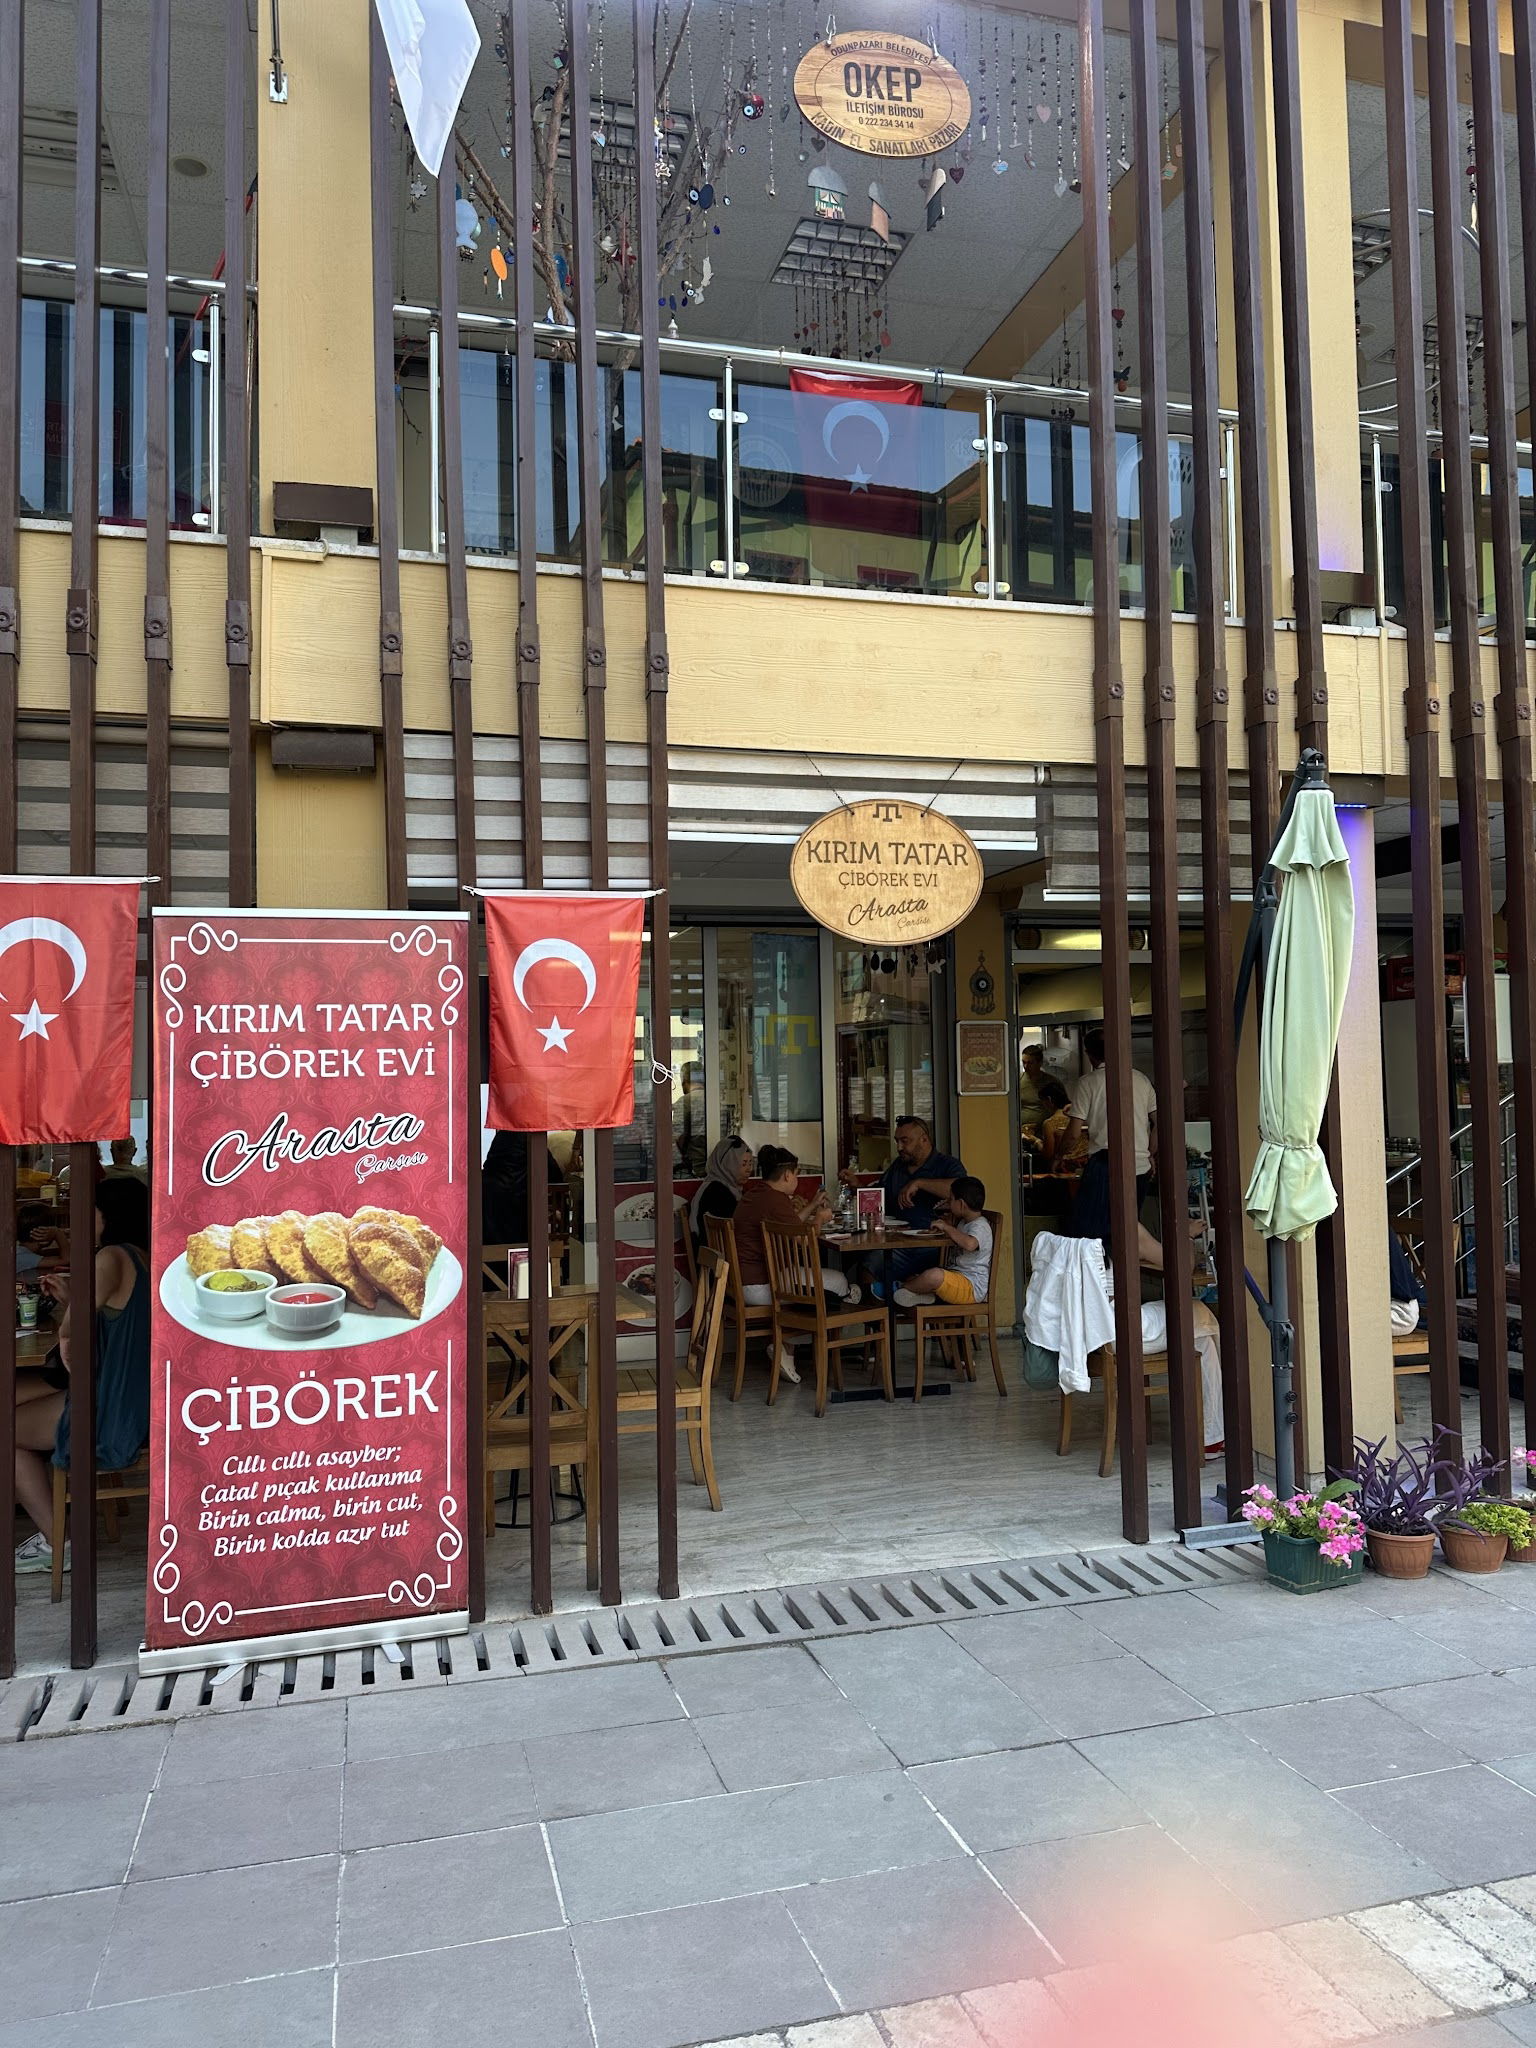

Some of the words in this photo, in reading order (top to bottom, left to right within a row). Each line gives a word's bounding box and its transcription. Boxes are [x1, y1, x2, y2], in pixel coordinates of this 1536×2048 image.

[830, 40, 883, 57] ODUNPAZARI
[843, 61, 922, 102] OKEP
[846, 101, 885, 116] İLETİŞİM
[888, 102, 924, 118] BÜROSU
[865, 117, 879, 126] 222
[880, 118, 894, 127] 234
[894, 120, 904, 128] 34
[905, 121, 914, 129] 14
[811, 112, 846, 141] KADIN
[850, 134, 867, 149] EL
[869, 139, 929, 155] SANATLARI
[929, 122, 963, 148] PAZARI
[806, 840, 881, 864] KIRIM
[888, 842, 969, 866] TATAR
[847, 897, 929, 926] Arasta
[193, 1004, 306, 1033] KIRIM
[316, 1003, 435, 1032] TATAR
[190, 1043, 365, 1088] ÇİBÖREK
[376, 1041, 436, 1077] EVİ
[201, 1111, 425, 1187] Arasta
[355, 1152, 428, 1184] Çarşısı
[181, 1369, 439, 1446] ÇİBÖREK
[222, 1455, 266, 1476] Cıllı
[271, 1450, 310, 1471] cıllı
[316, 1444, 402, 1468] asayber;
[200, 1482, 258, 1509] Çatal
[263, 1476, 320, 1503] pıçak
[325, 1468, 422, 1492] kullanma
[198, 1509, 251, 1531] Birin
[256, 1504, 326, 1527] calma,
[333, 1499, 381, 1518] birin
[387, 1493, 423, 1513] cut,
[214, 1535, 266, 1557] Birin
[272, 1529, 330, 1550] kolda
[335, 1526, 376, 1545] azır
[380, 1519, 410, 1538] tut
